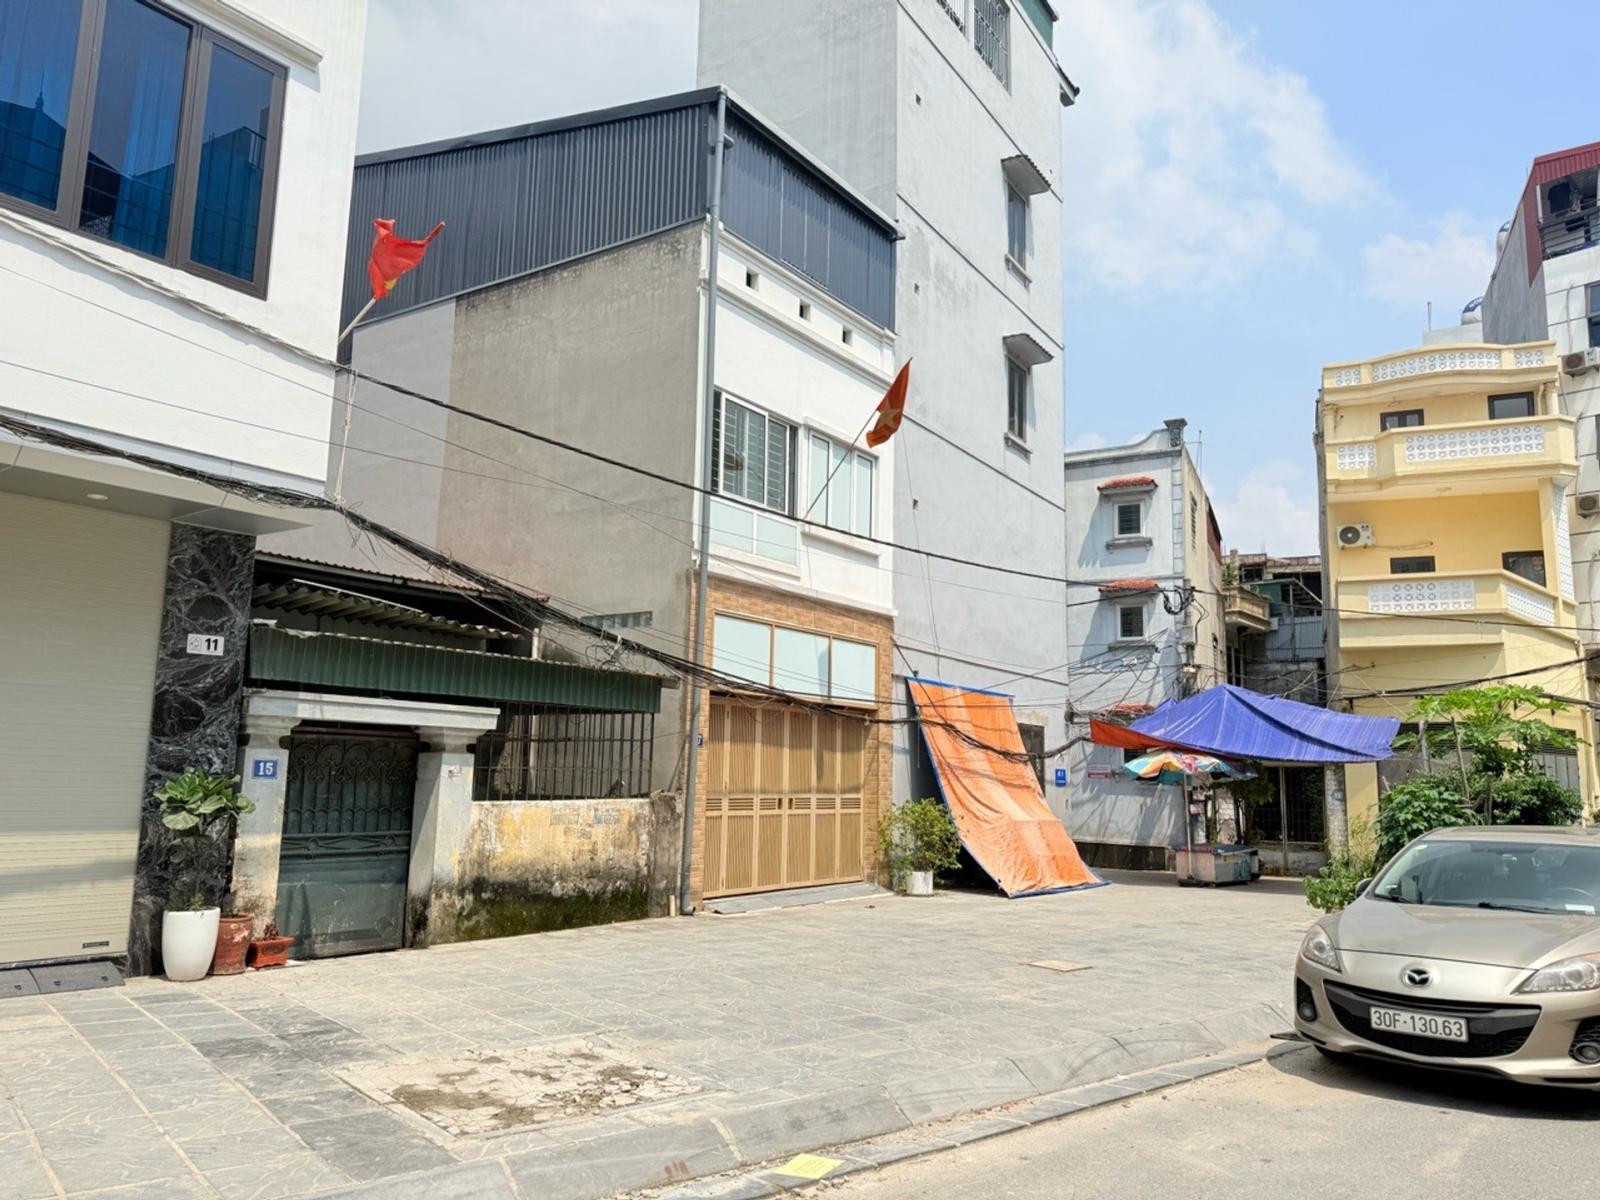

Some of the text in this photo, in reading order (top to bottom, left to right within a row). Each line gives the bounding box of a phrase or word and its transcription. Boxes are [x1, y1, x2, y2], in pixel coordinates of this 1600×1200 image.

[205, 638, 218, 650] 11
[259, 762, 273, 775] 15
[1373, 1010, 1463, 1038] 30F-130.63
